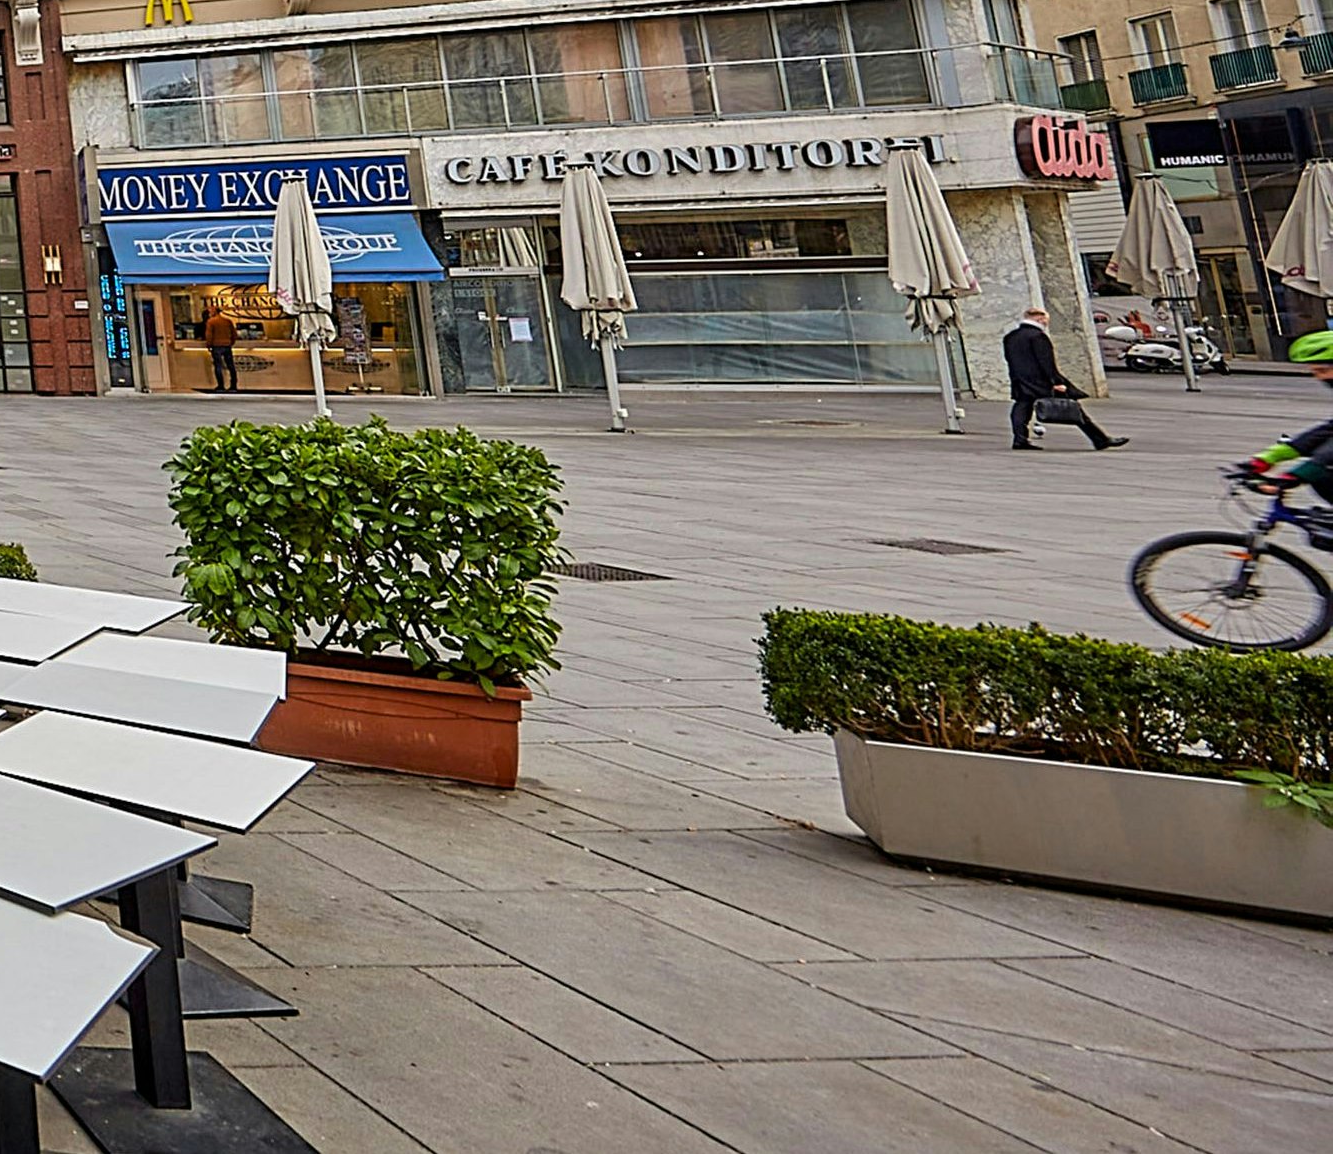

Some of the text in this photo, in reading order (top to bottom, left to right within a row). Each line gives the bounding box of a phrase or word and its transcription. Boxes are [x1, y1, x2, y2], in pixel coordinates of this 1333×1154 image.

[445, 149, 568, 184] CAFÉ
[1160, 154, 1225, 166] HUMANIC
[98, 173, 210, 211] MONEY
[137, 239, 185, 256] THE
[202, 295, 230, 309] THE
